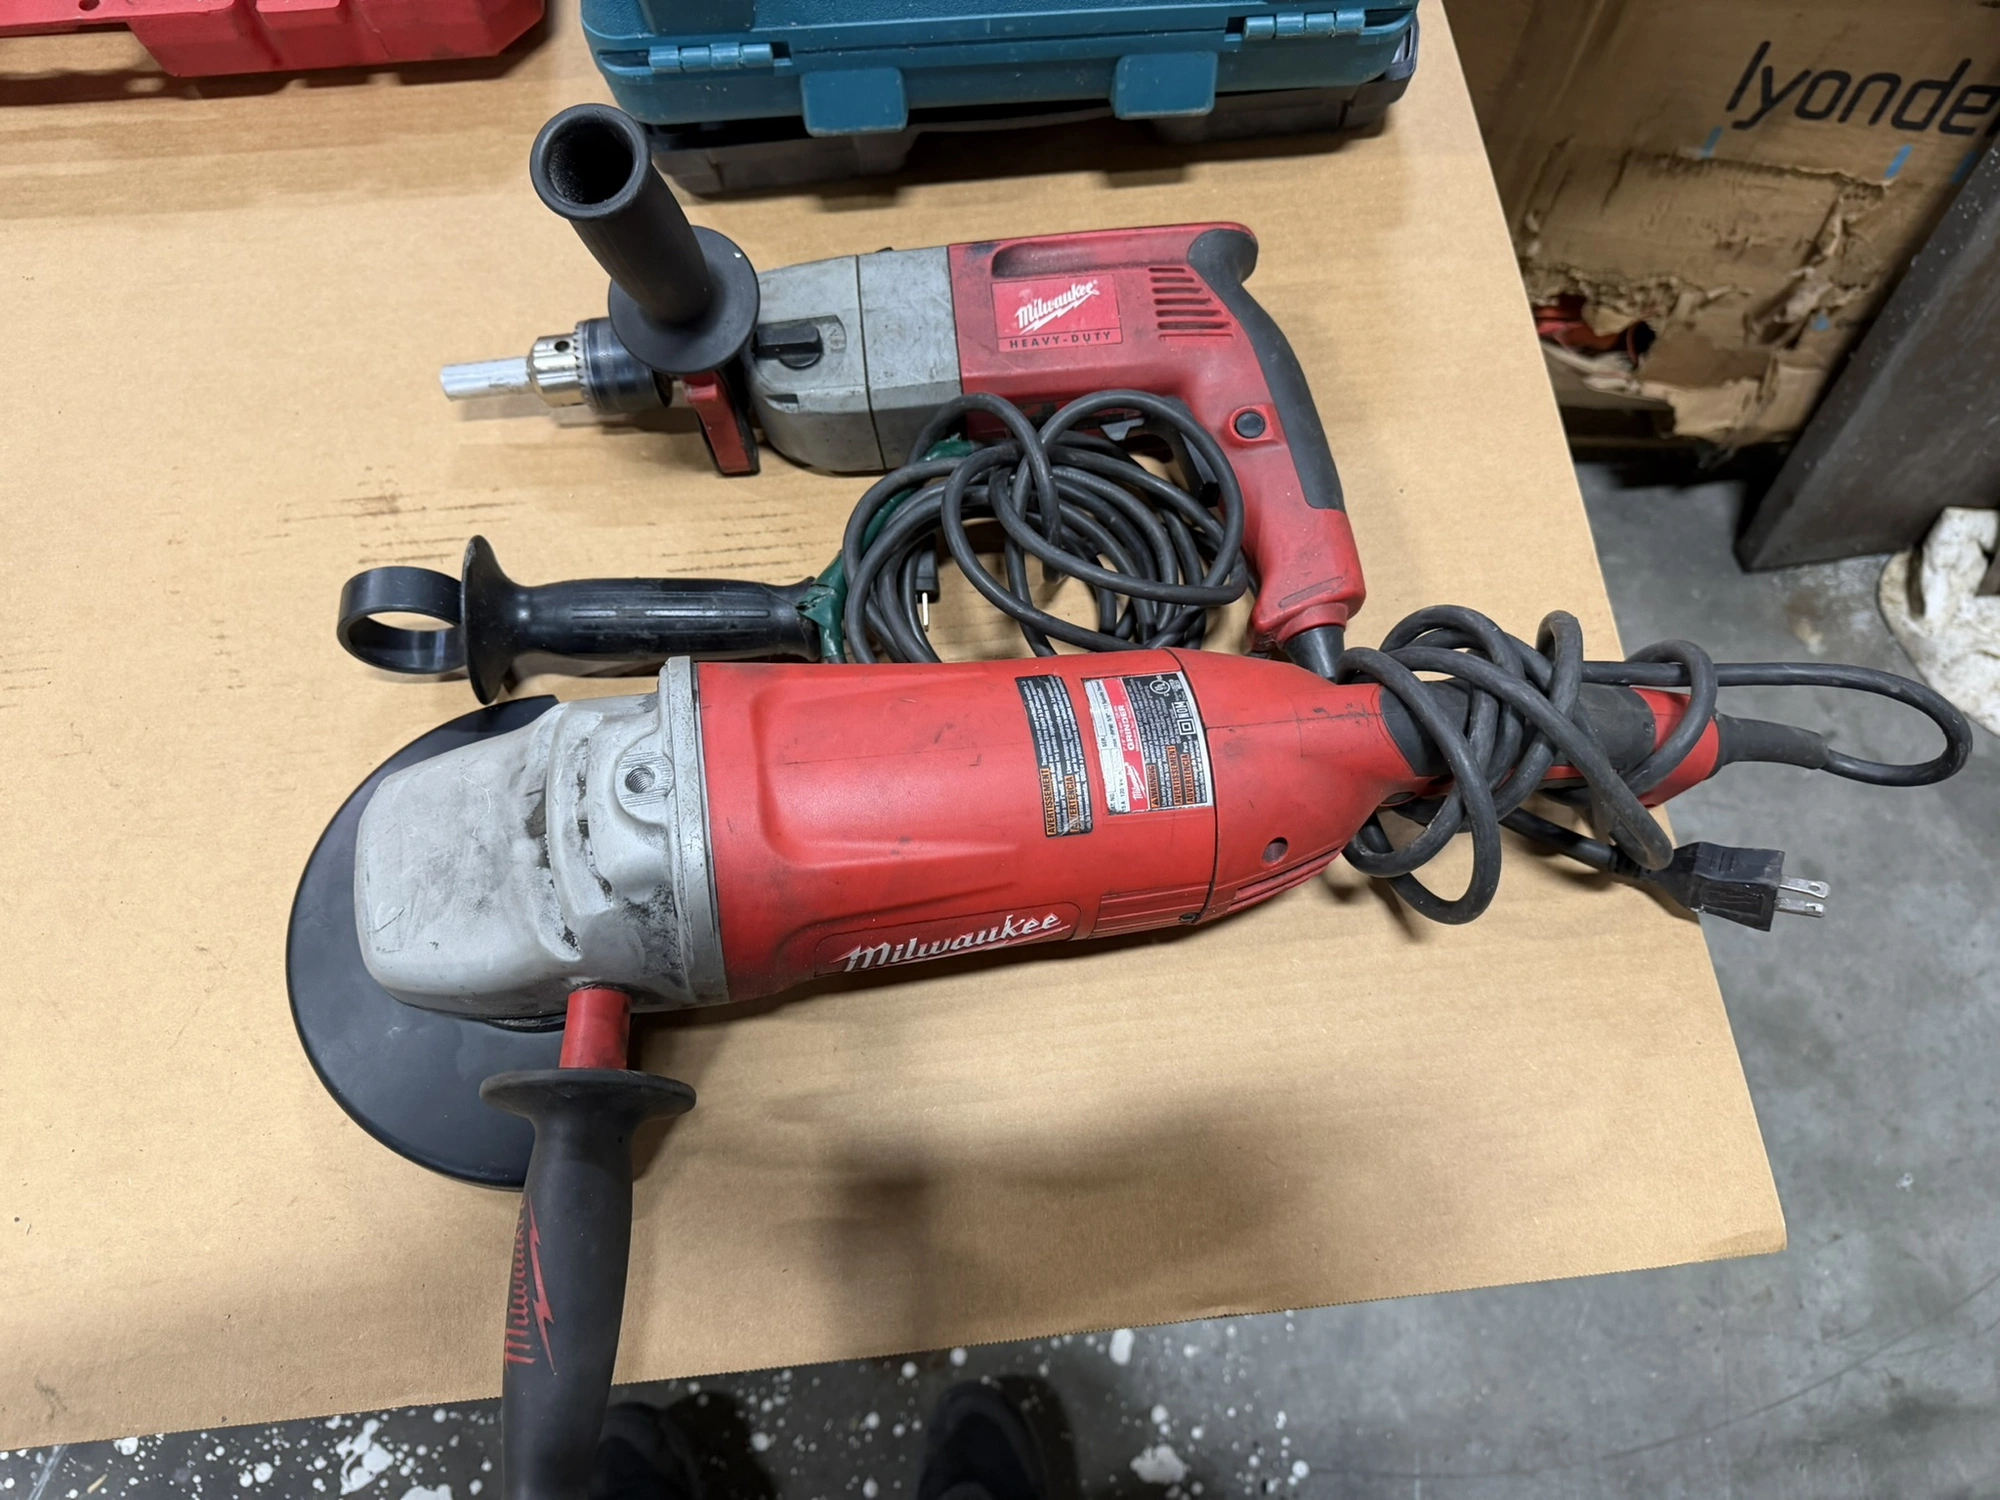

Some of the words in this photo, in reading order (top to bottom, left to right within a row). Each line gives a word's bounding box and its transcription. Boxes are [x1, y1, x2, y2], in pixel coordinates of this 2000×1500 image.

[1014, 280, 1095, 329] Milwaukee
[1009, 331, 1111, 349] HEAVY-DUTY
[1118, 705, 1134, 750] GRINDER
[1174, 701, 1189, 718] NOM
[1148, 766, 1157, 798] WARNING
[1168, 747, 1181, 803] AVERTISSEMENT
[1182, 755, 1193, 802] ADVERTENCIA
[1041, 770, 1055, 833] AVERTISSEMENT
[834, 912, 1062, 973] Milwaukee
[503, 1194, 537, 1375] Milwauk
